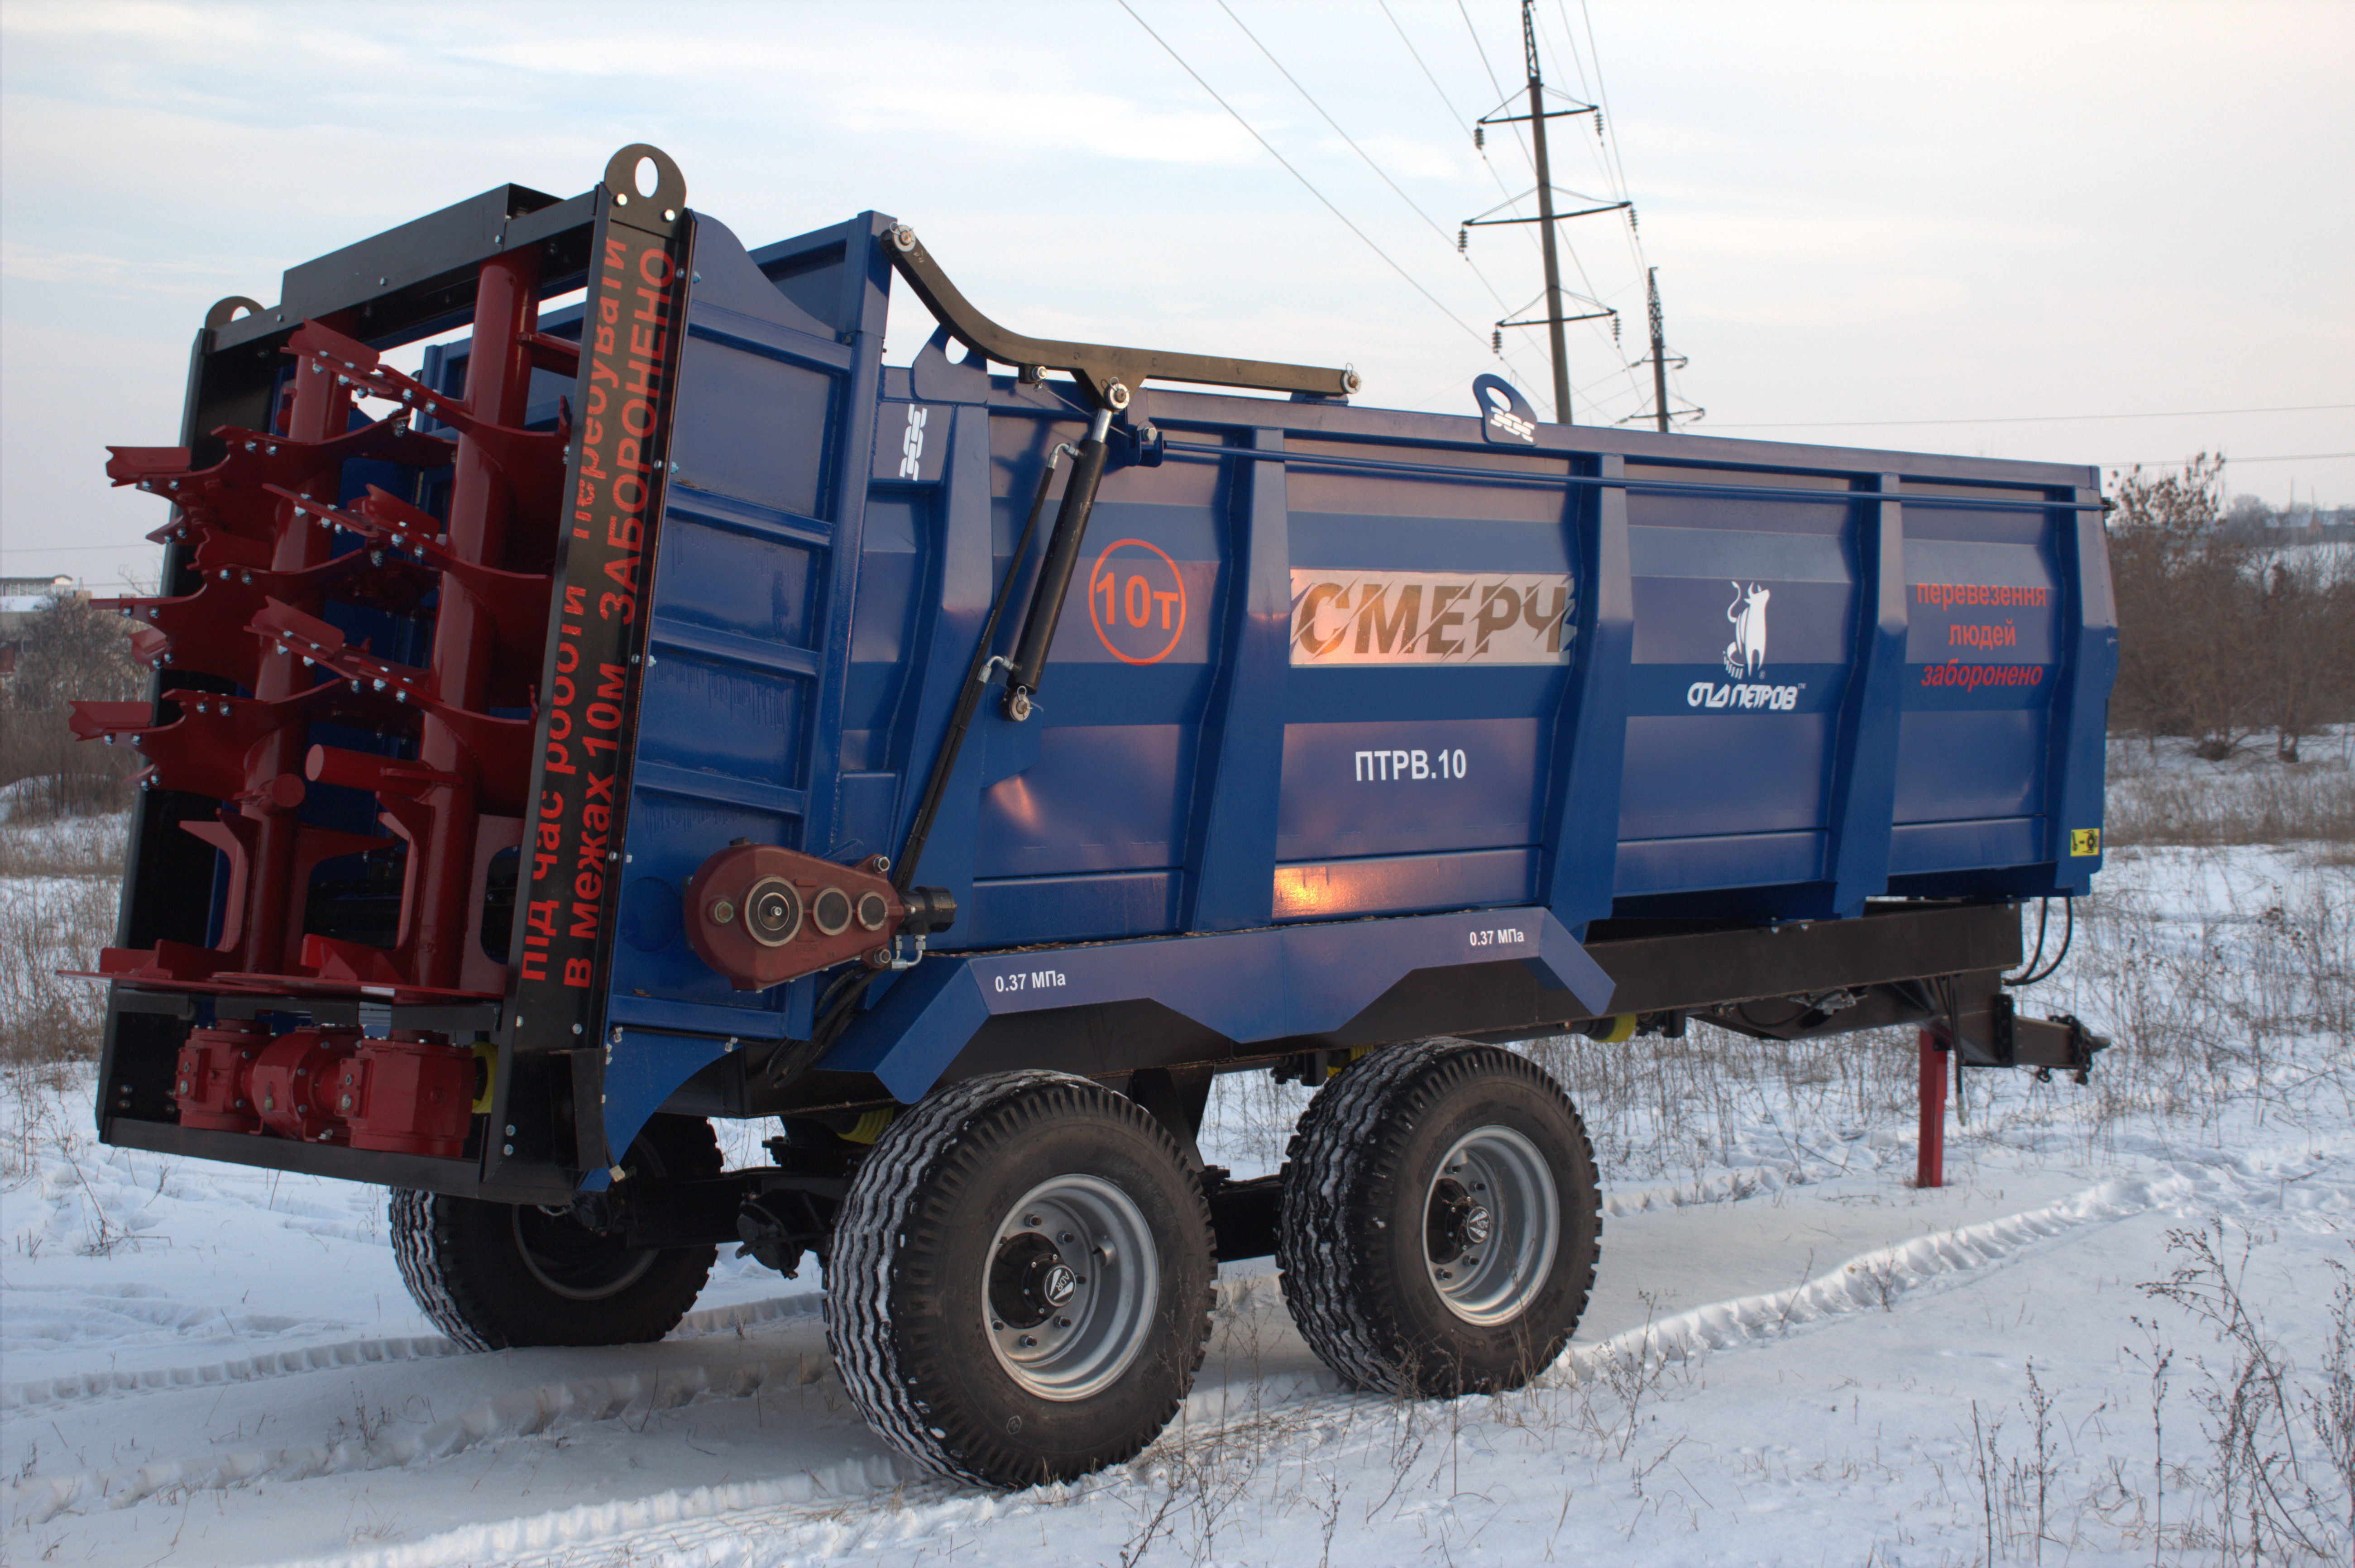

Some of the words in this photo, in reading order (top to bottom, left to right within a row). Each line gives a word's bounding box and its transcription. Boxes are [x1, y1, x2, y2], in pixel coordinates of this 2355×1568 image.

[599, 248, 675, 625] ЗАБОРОНЕНО
[1916, 583, 2046, 611] перевезення
[1292, 577, 1567, 664] СМЕРЧ
[1948, 618, 2016, 650] людей
[1920, 658, 2043, 693] заборонено
[582, 663, 625, 756] 10м
[1355, 749, 1466, 781] ПТРВ.10
[533, 791, 564, 880] час
[570, 774, 614, 939] межах
[1469, 932, 1493, 946] 0.37
[1498, 928, 1524, 944] МПа
[995, 974, 1026, 992] 0.37
[1032, 970, 1066, 989] МПа
[1055, 1271, 1069, 1291] ADR
